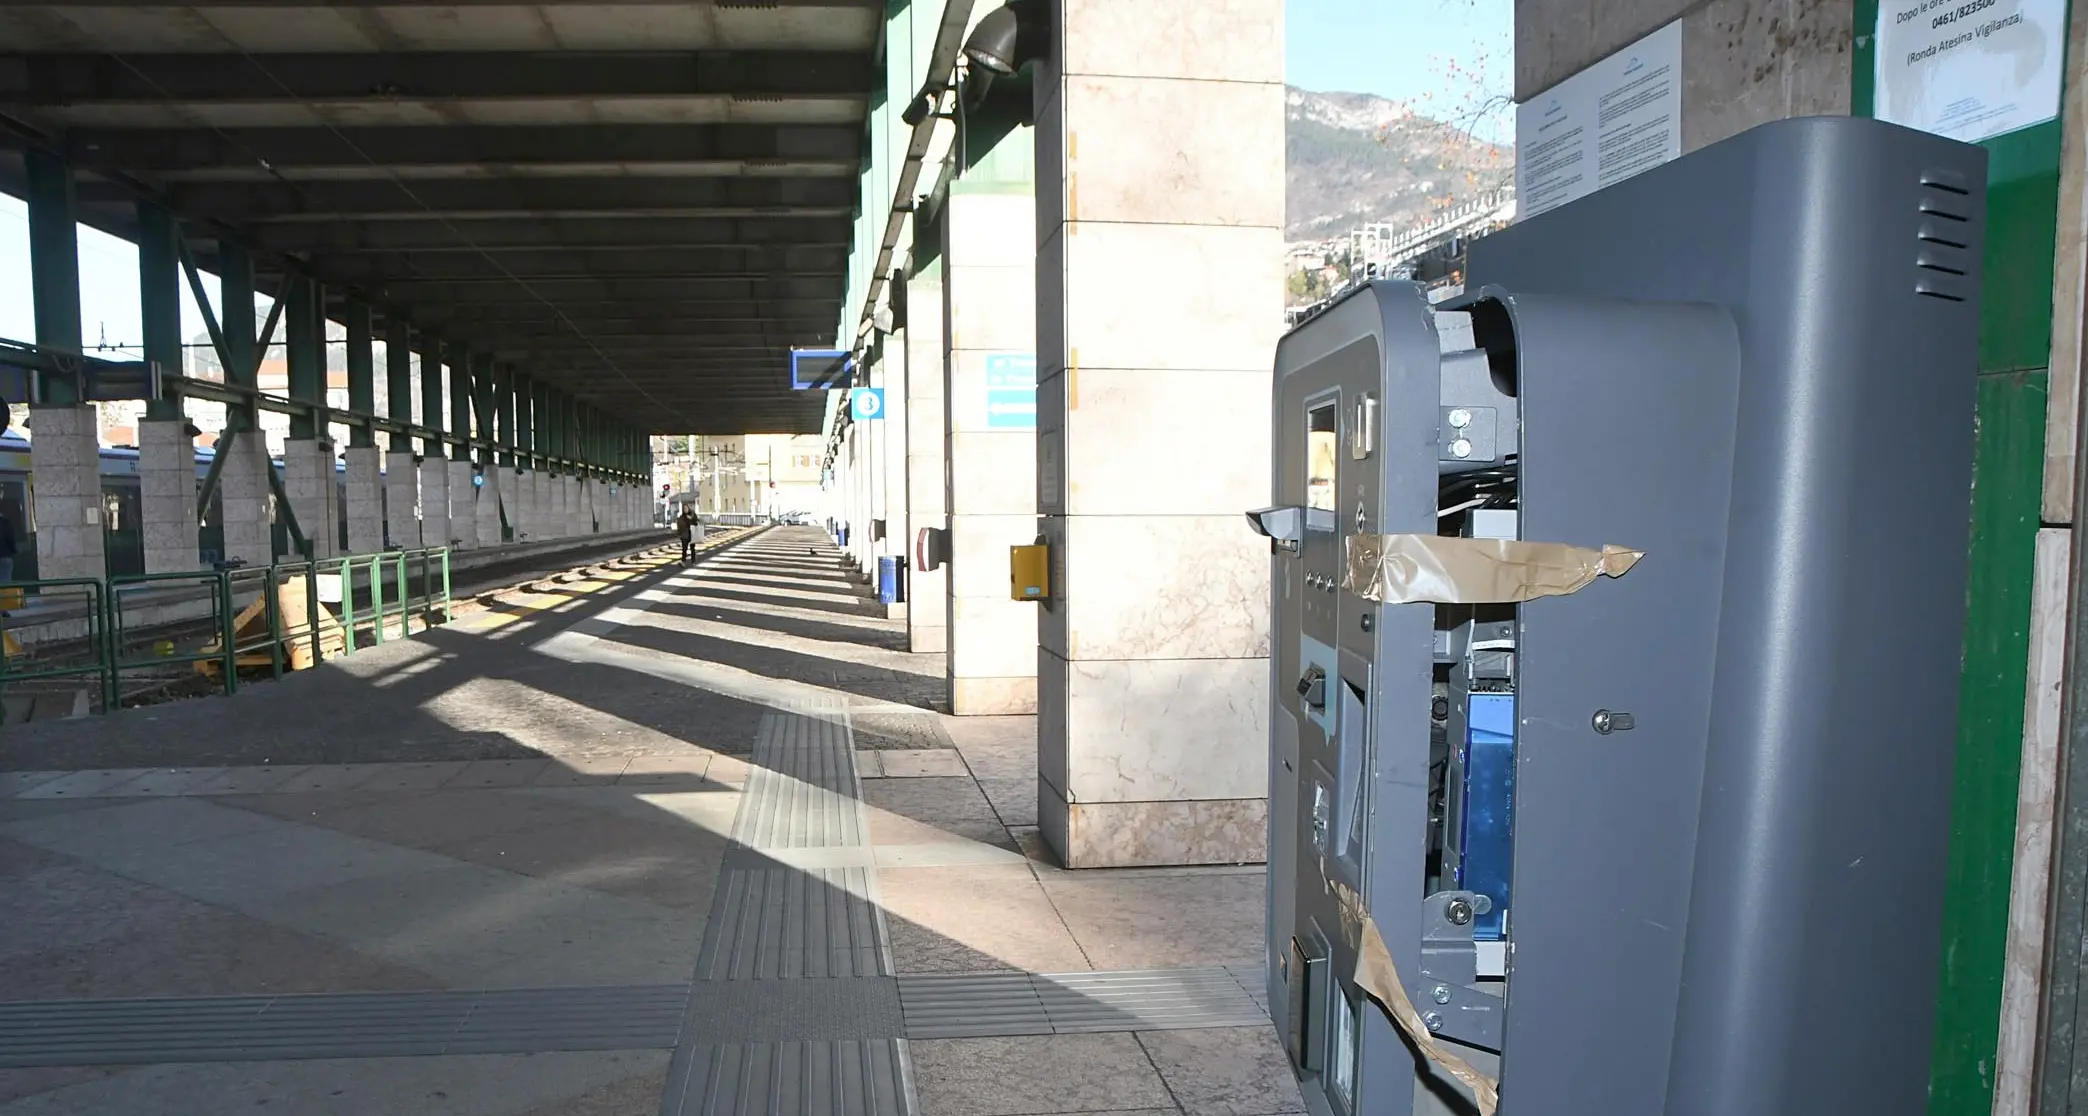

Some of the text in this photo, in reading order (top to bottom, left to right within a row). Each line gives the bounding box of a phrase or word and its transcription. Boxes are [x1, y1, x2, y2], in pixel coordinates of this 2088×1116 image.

[1897, 8, 1918, 24] Dopo
[1920, 3, 1928, 13] le
[1907, 45, 1936, 67] (Ronda
[1939, 32, 1972, 52] Atesina
[864, 396, 873, 411] 3
